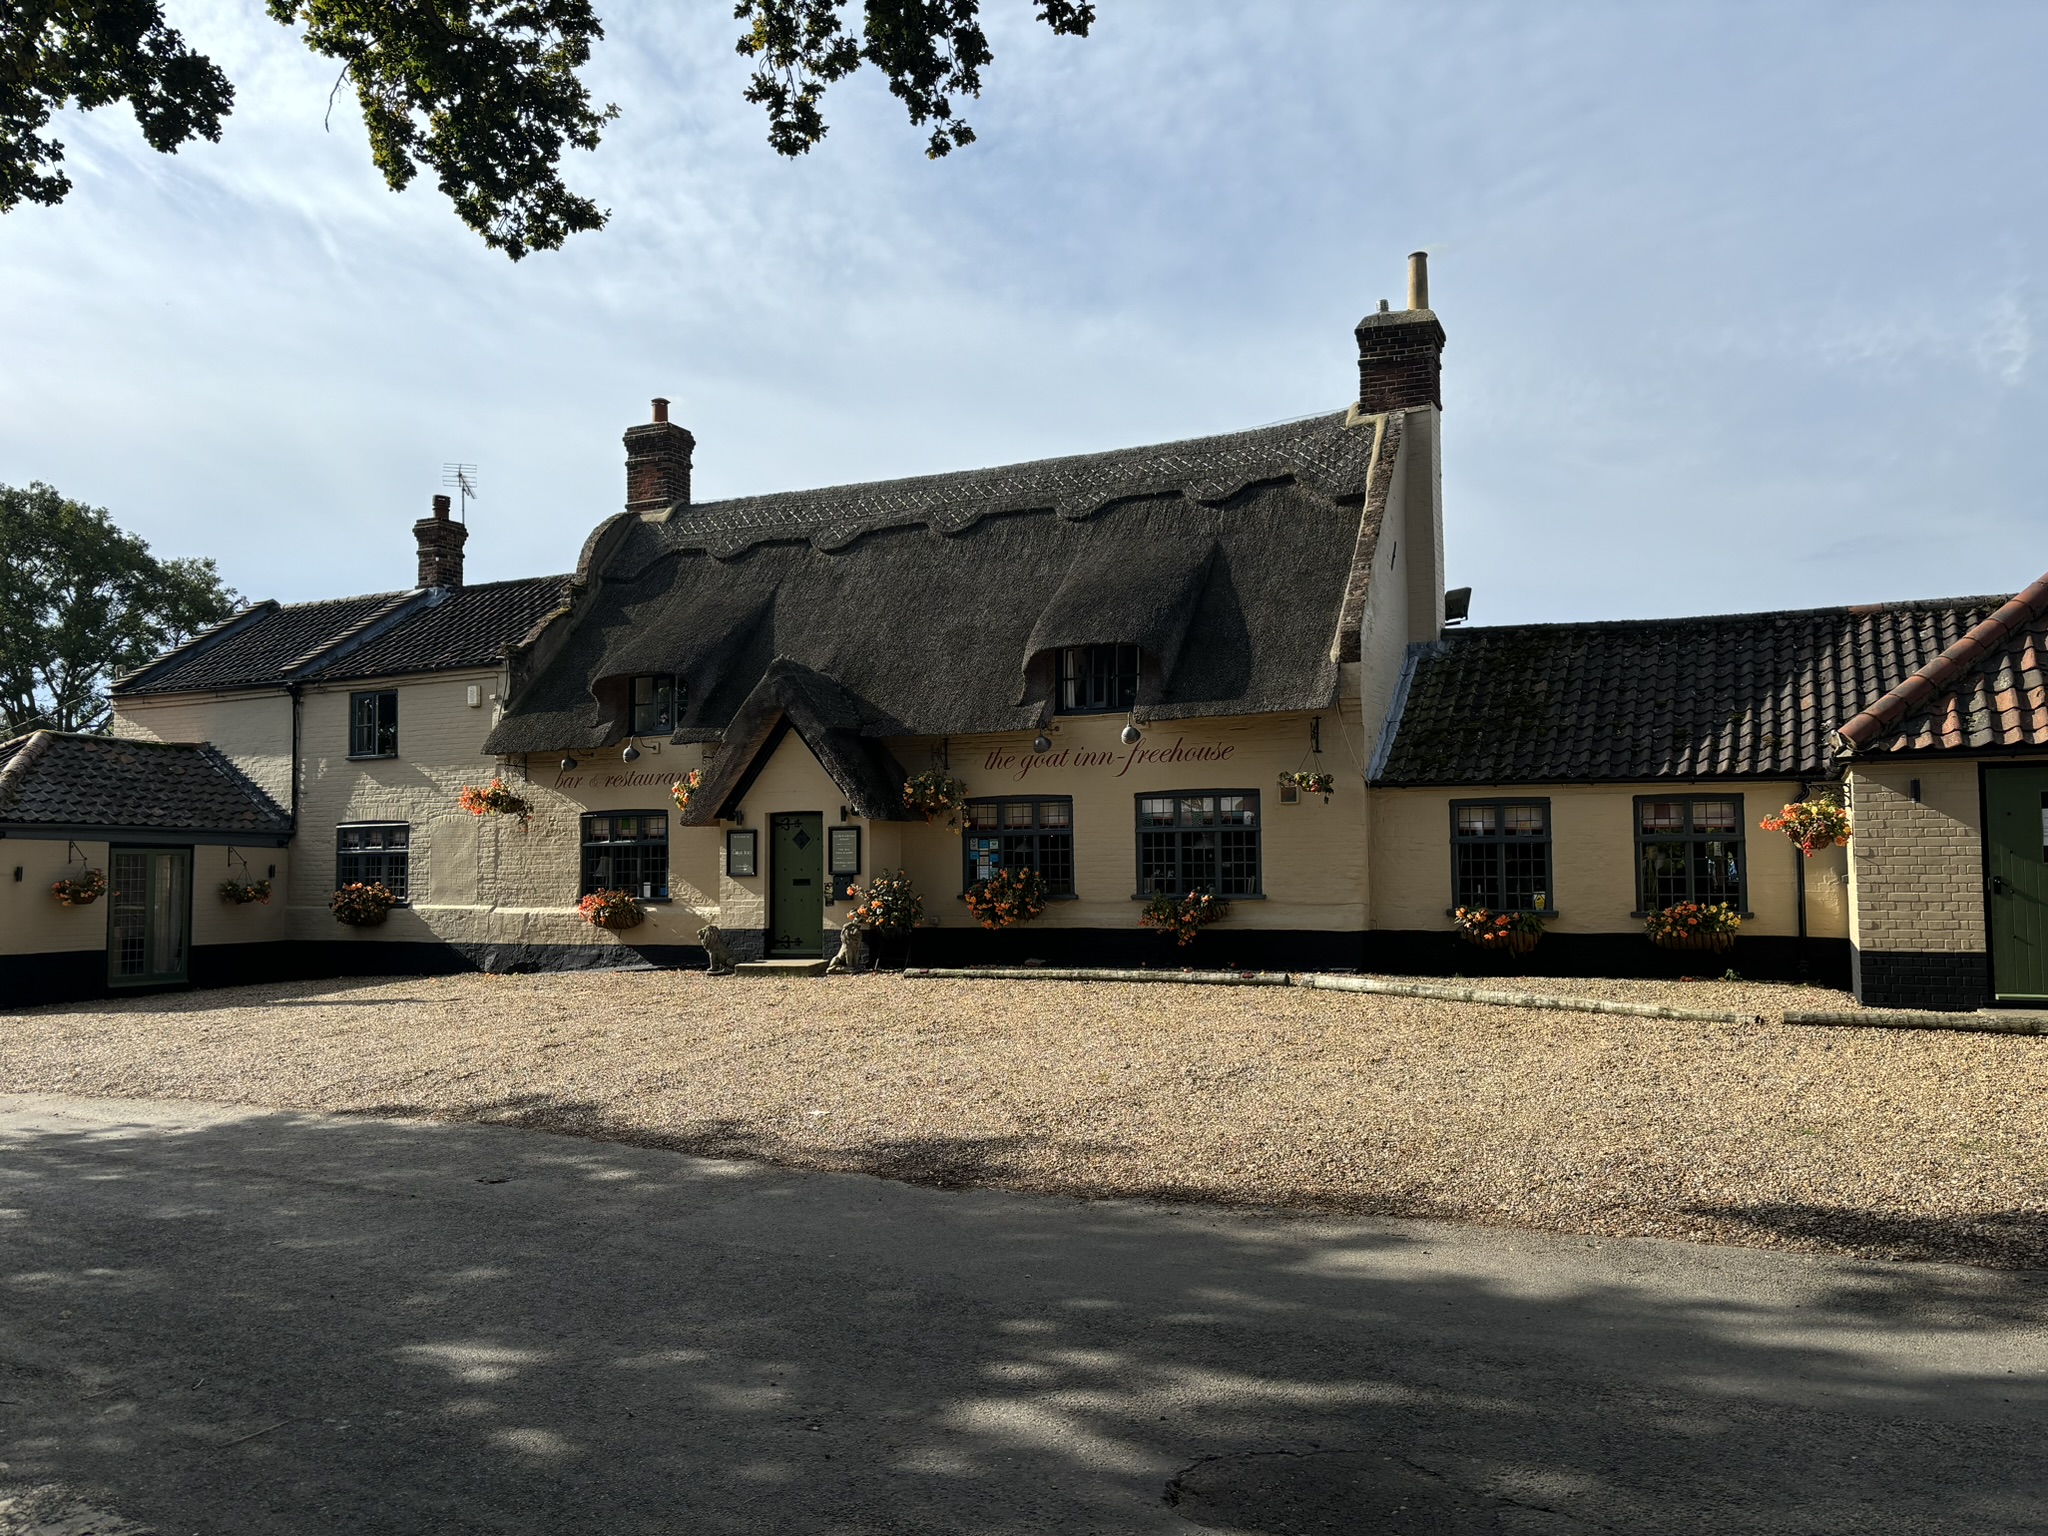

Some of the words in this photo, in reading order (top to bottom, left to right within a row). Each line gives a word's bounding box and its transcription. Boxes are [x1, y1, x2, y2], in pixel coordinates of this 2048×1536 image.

[984, 747, 1016, 771] the
[1013, 748, 1070, 782] goat
[554, 770, 584, 790] bar
[589, 774, 599, 789] &
